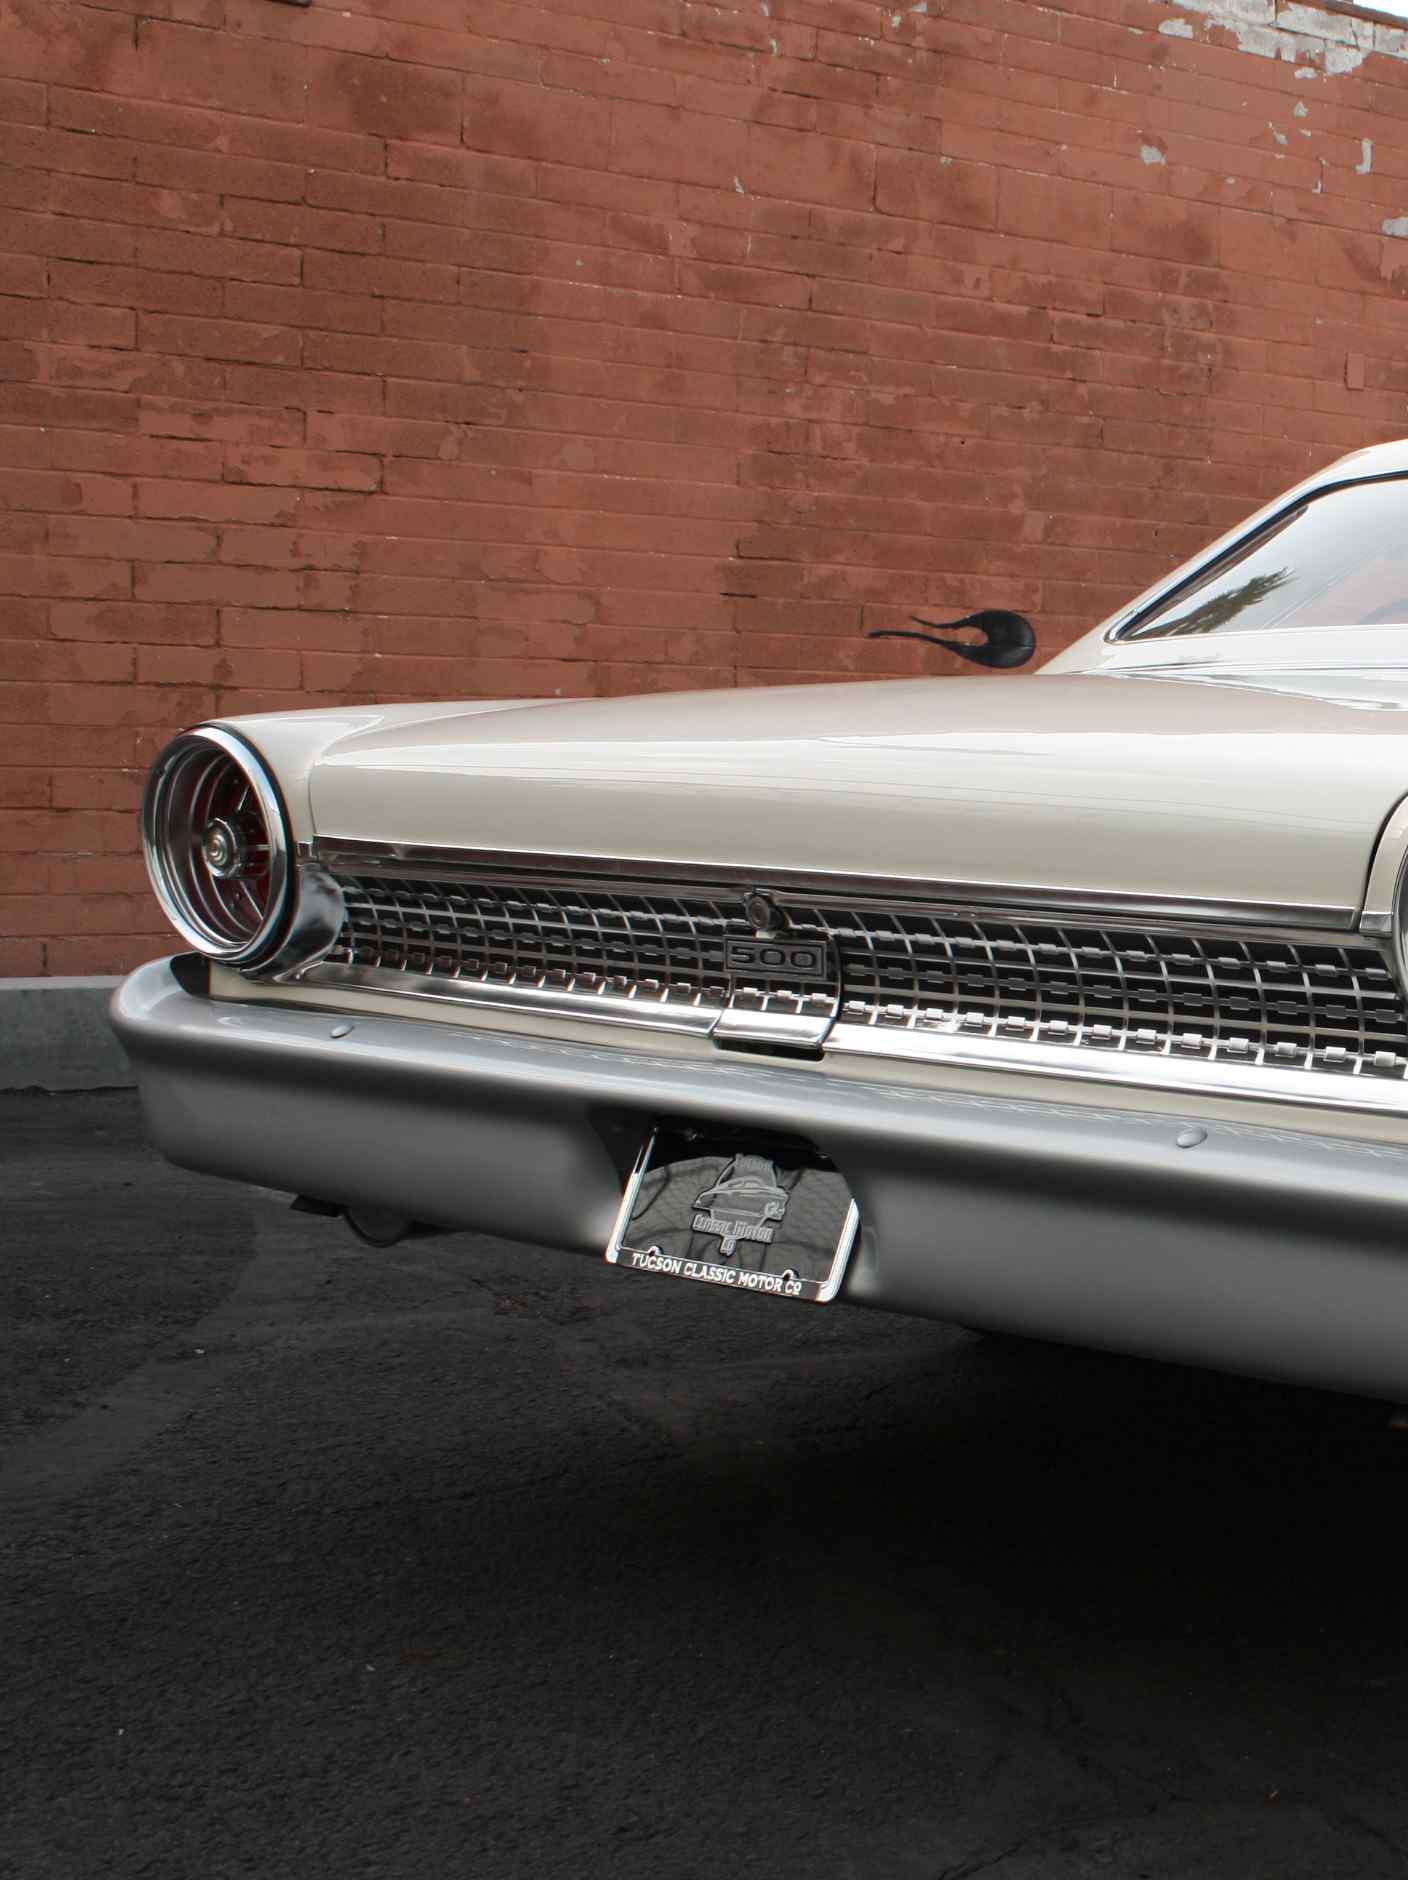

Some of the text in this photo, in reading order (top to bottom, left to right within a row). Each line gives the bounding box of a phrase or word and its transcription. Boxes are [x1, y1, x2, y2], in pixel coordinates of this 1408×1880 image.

[730, 947, 817, 970] 500
[631, 1252, 681, 1275] TUCSON
[682, 1262, 736, 1285] CLASSIC
[737, 1271, 783, 1293] MOTOR
